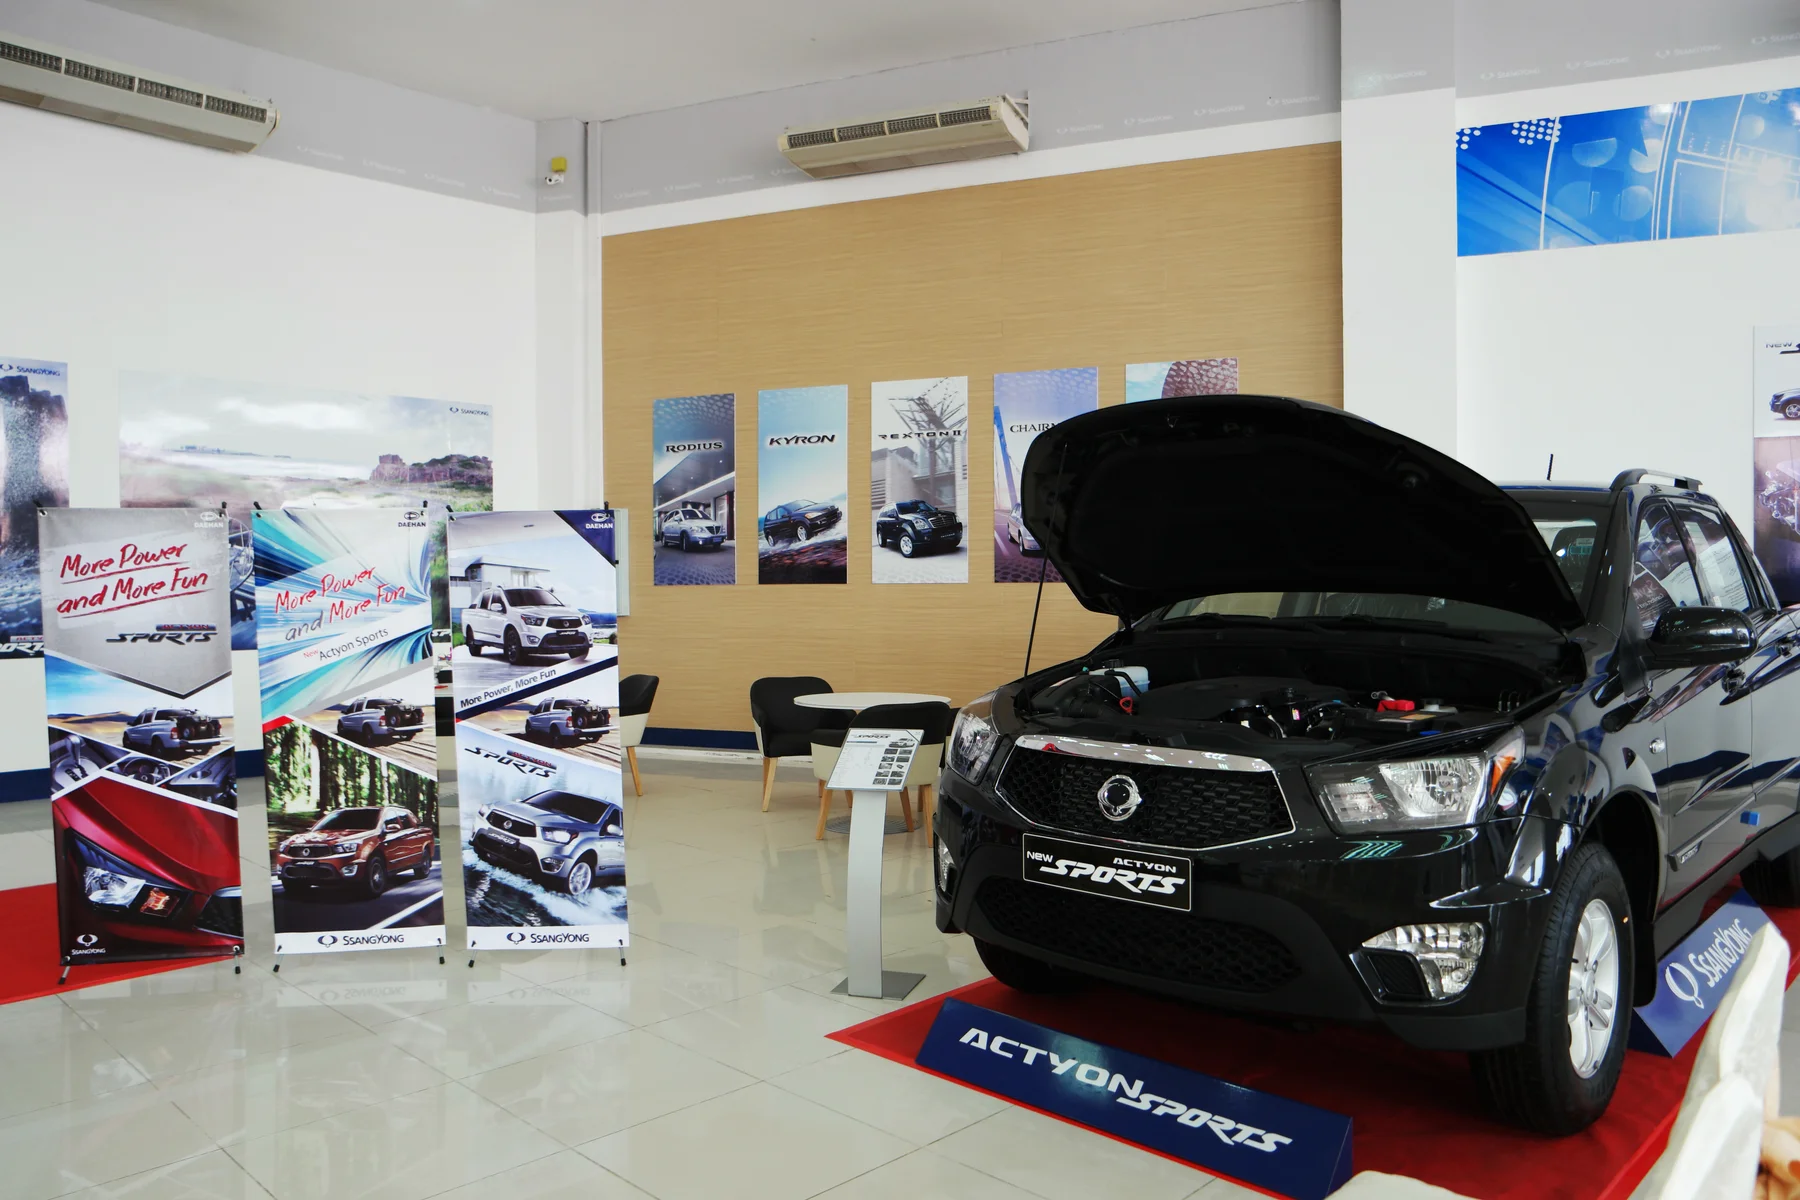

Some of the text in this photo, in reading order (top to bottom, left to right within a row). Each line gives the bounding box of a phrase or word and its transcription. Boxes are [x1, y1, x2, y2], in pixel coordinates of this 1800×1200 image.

[16, 365, 61, 377] SSANGYONG
[665, 441, 723, 453] RODIUS
[769, 434, 836, 446] KYRON
[878, 431, 949, 440] REXTON
[194, 521, 224, 529] DAEHAN
[585, 522, 614, 530] DAEHAN
[60, 543, 188, 578] More Power
[57, 566, 209, 614] and More Fun
[275, 566, 376, 613] More Power
[285, 583, 406, 641] and More Fun
[106, 632, 218, 645] SPORTS
[303, 628, 389, 661] New Actyon Sports
[460, 669, 557, 708] More Power, More Fun
[464, 747, 557, 778] SPORTS
[1039, 858, 1186, 895] SPORTS
[1112, 857, 1177, 874] ACTYON
[343, 934, 405, 946] SSANGYONG
[530, 932, 590, 944] SSANGYONG
[1688, 918, 1753, 988] SSANGYONG
[958, 1027, 1293, 1153] ACTYON SPORTS
